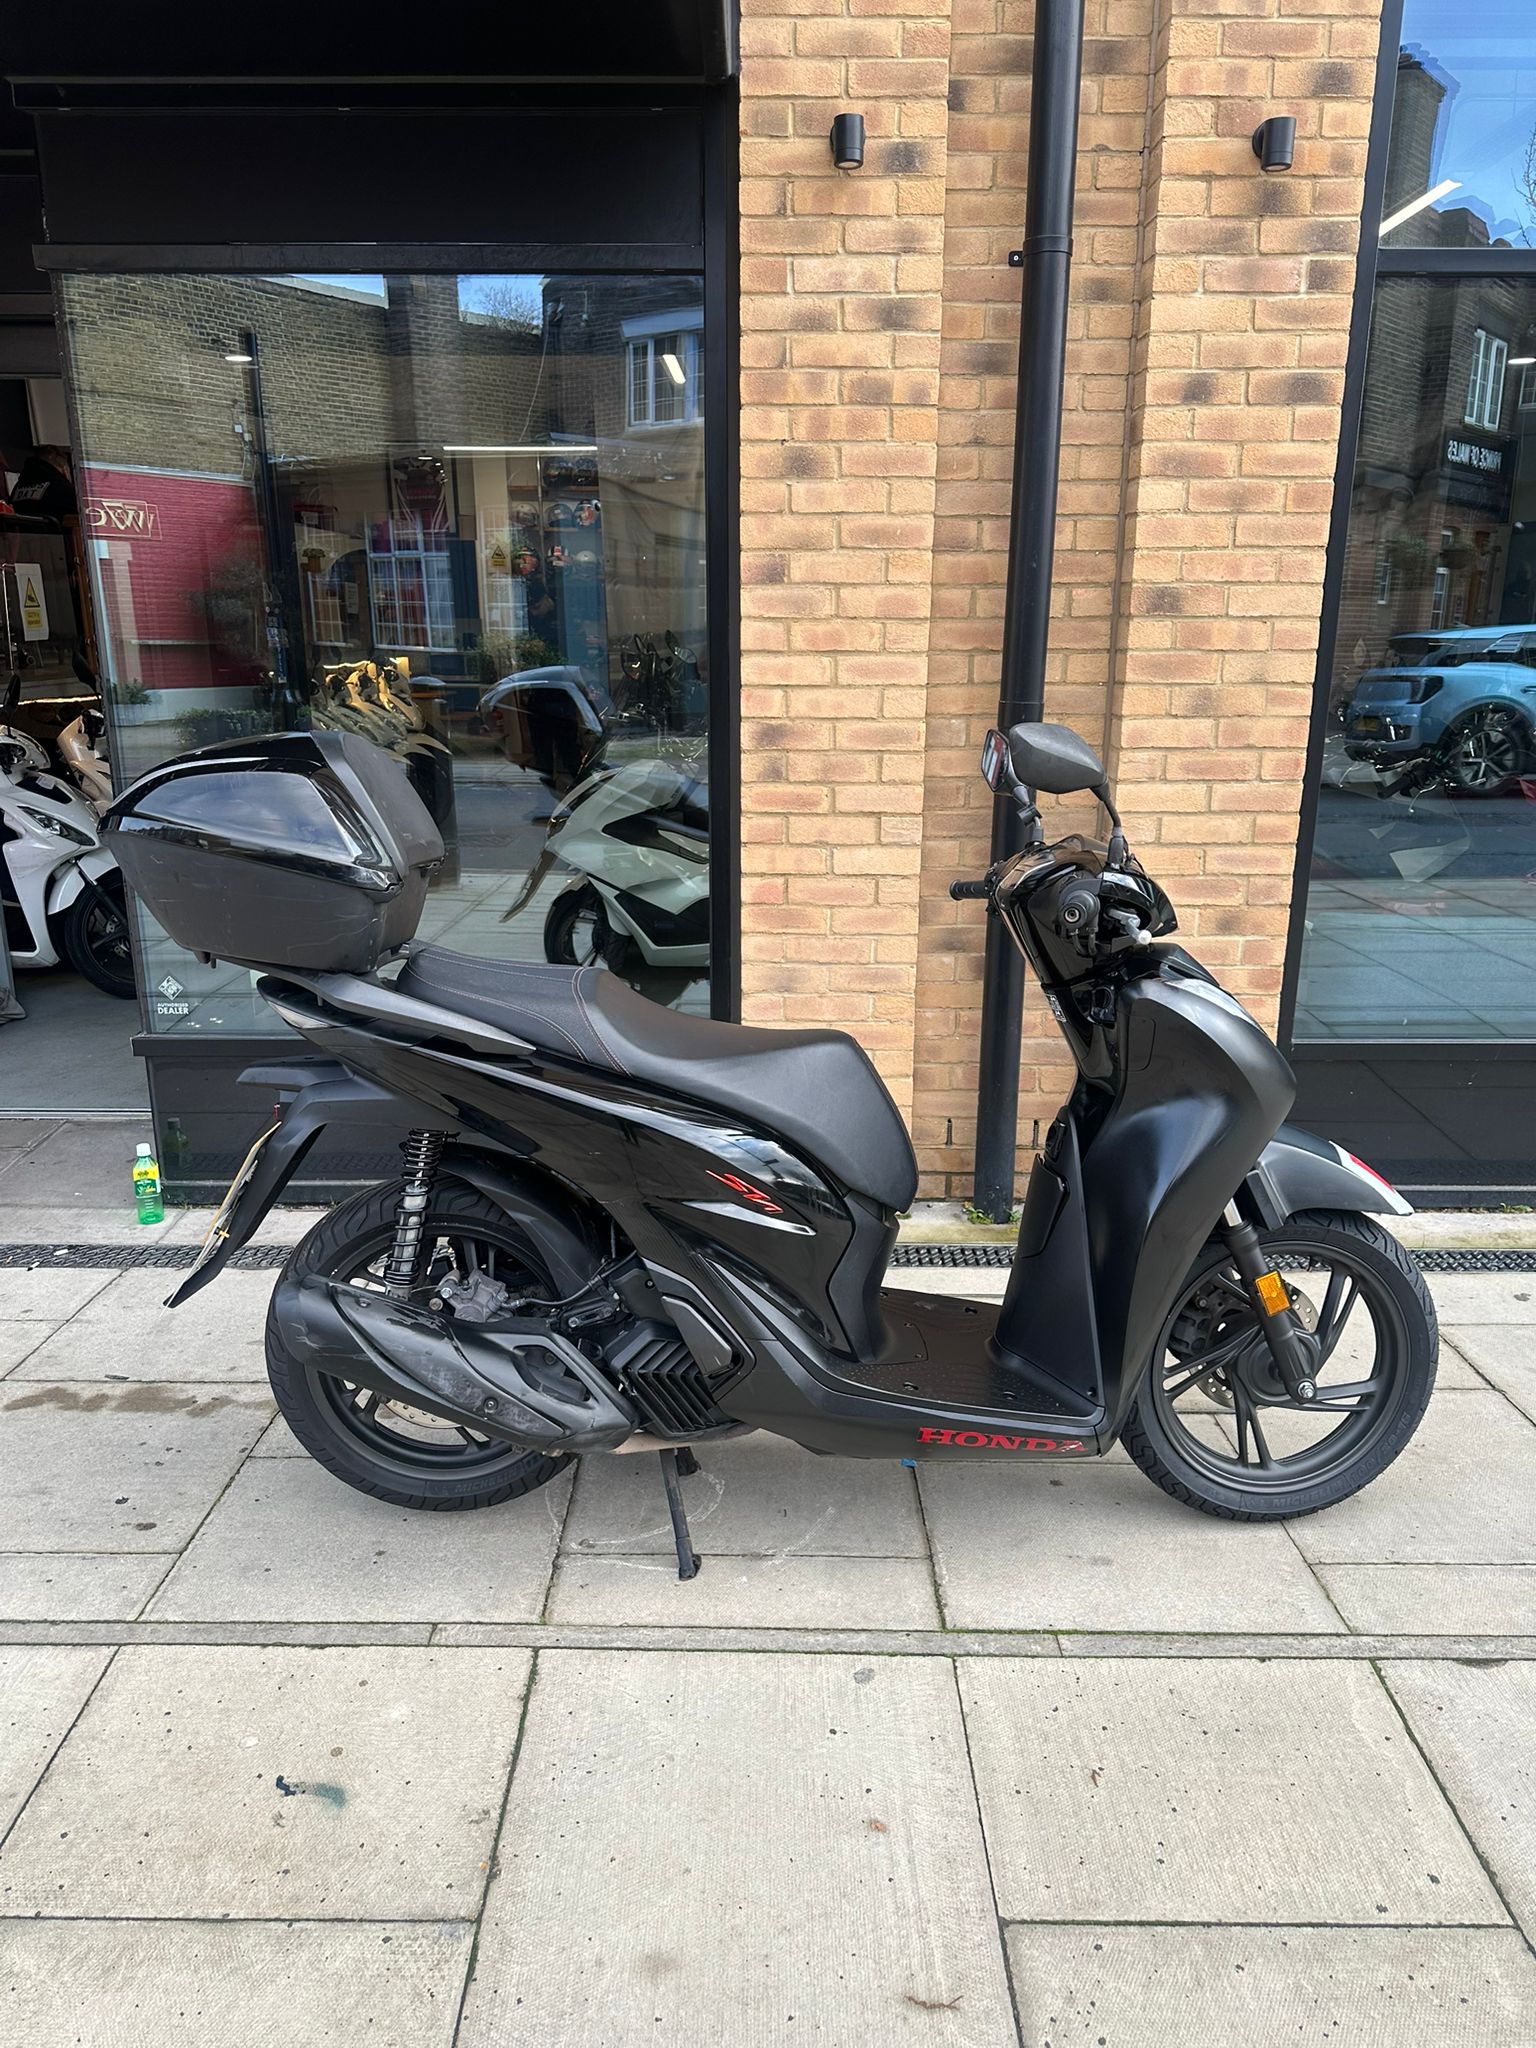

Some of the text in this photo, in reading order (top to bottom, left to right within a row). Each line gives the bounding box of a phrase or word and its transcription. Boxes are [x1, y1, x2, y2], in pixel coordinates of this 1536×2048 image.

[157, 1007, 190, 1015] DEALER
[916, 1427, 1088, 1453] HONDA
[455, 1463, 523, 1493] MICHELIN
[1273, 1474, 1346, 1508] MICHELIN
